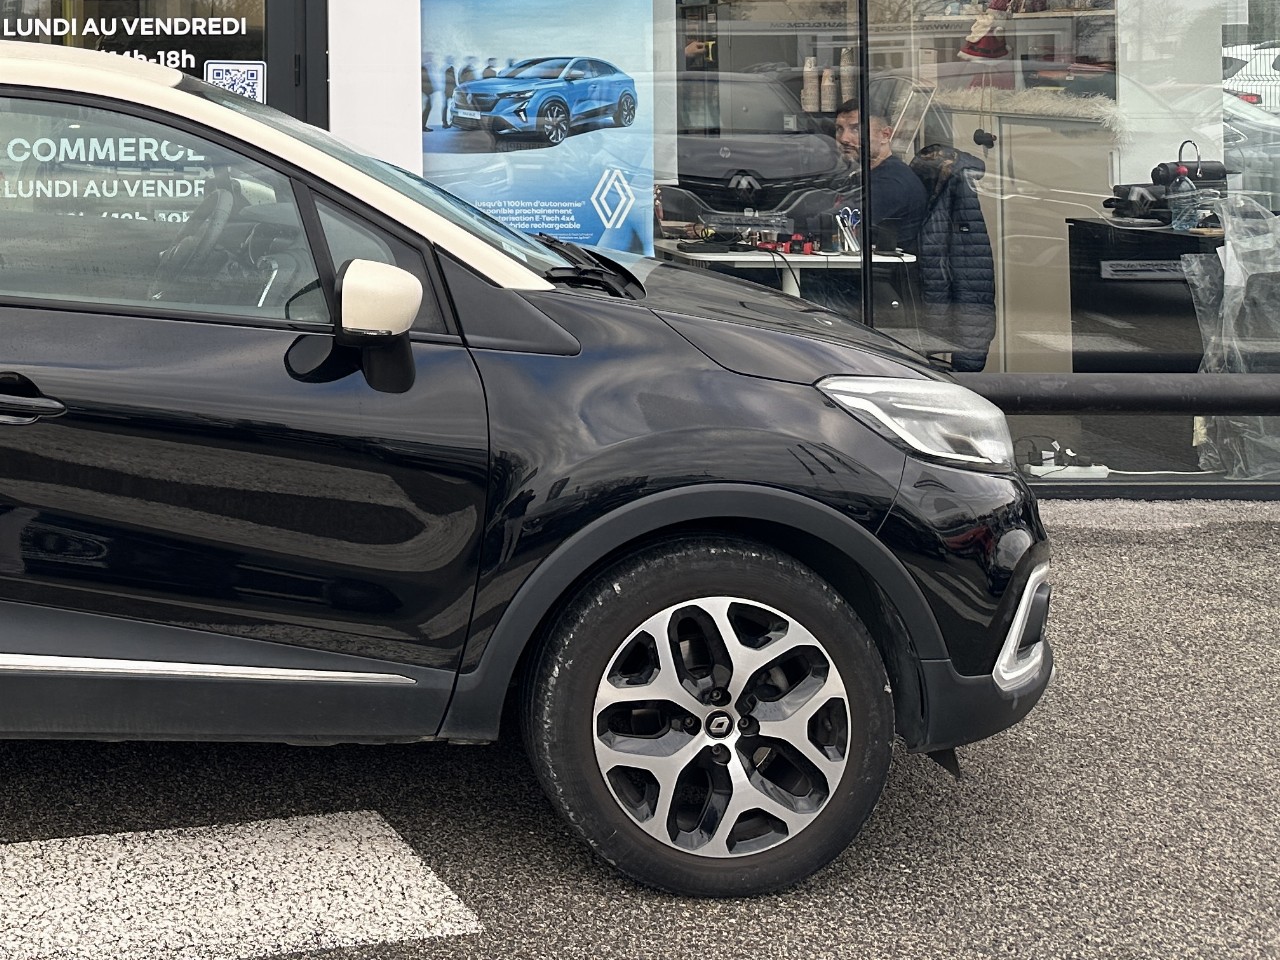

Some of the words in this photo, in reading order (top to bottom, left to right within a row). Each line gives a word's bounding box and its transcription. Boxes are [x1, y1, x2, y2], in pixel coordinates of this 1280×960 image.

[3, 17, 76, 36] LUNDI
[81, 17, 117, 36] AU
[121, 17, 247, 36] VENDREDI
[4, 179, 78, 198] LUNDI
[83, 179, 118, 198] AU
[123, 179, 206, 198] VENDR
